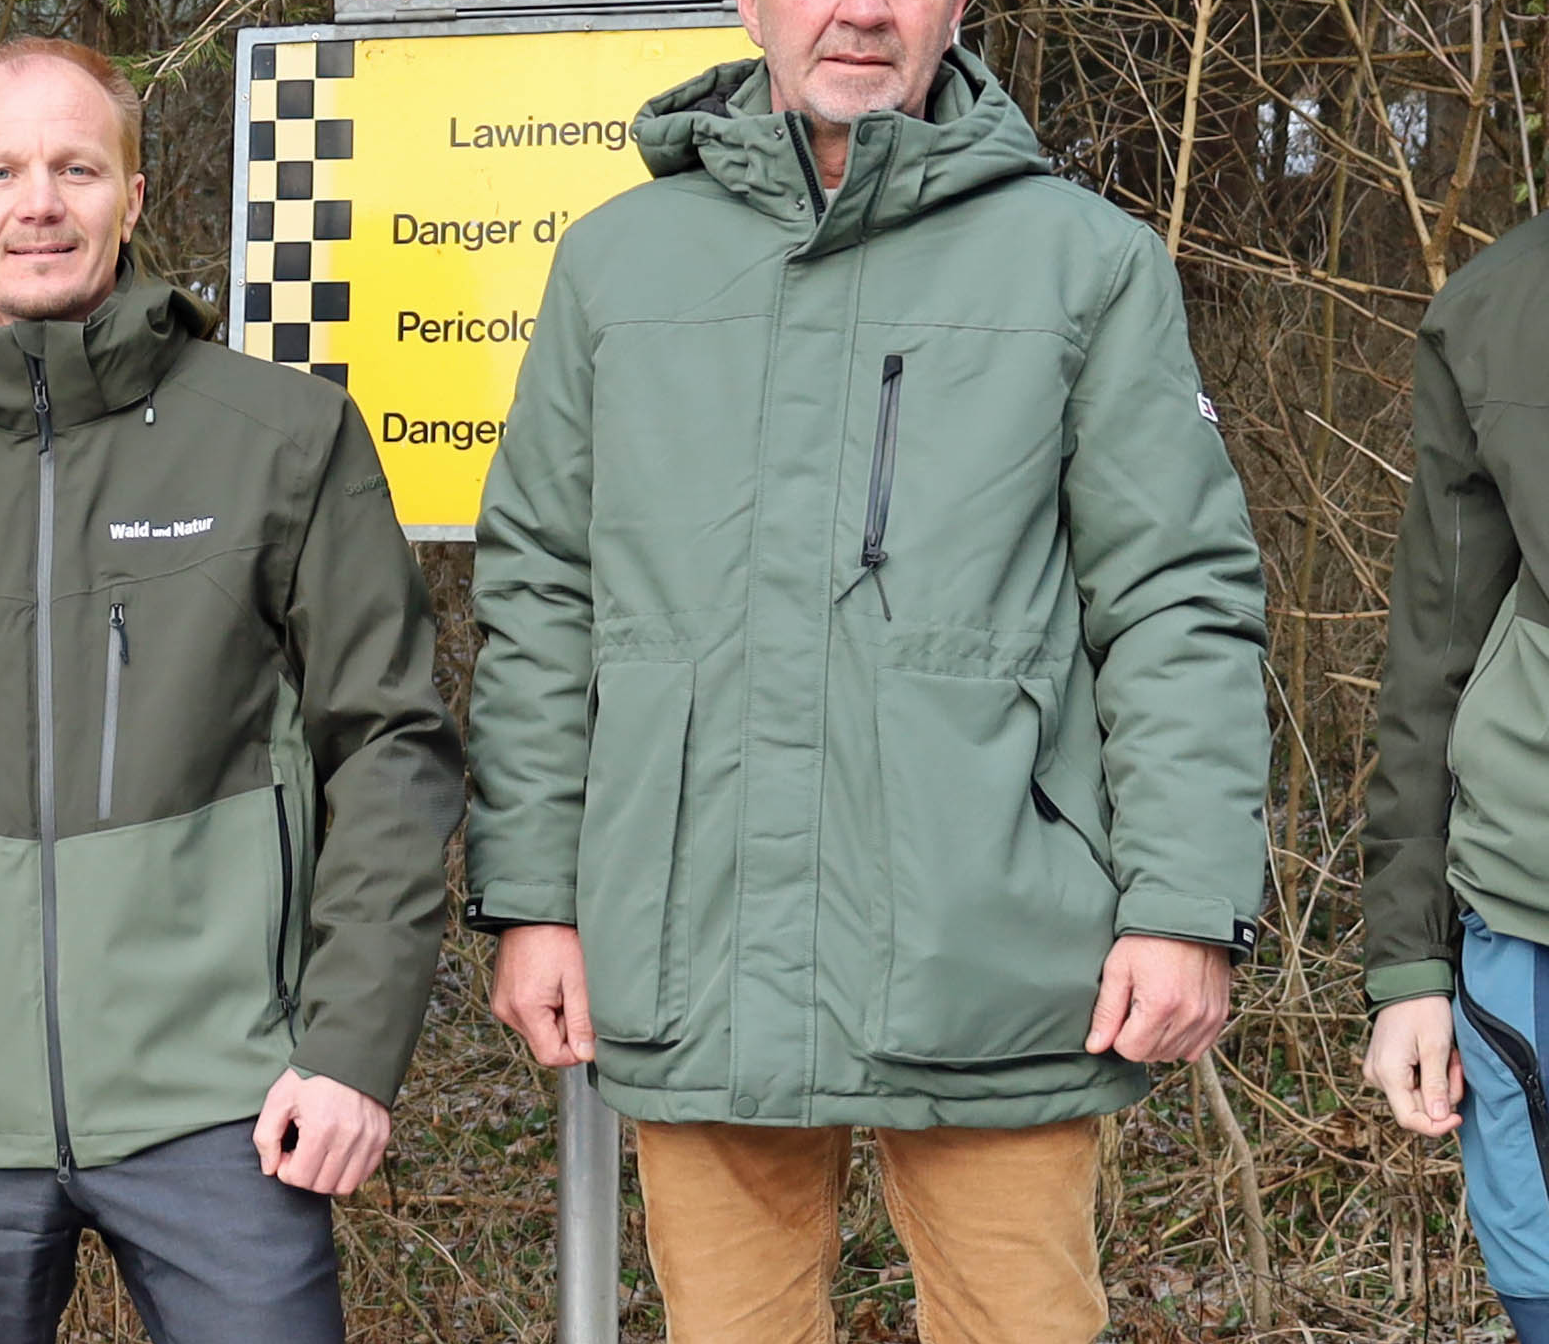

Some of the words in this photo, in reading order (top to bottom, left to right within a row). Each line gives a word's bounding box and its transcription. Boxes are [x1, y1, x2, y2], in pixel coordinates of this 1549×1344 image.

[392, 213, 522, 252] Danger
[109, 520, 150, 540] Wald
[151, 526, 172, 538] und
[173, 516, 214, 537] Natur
